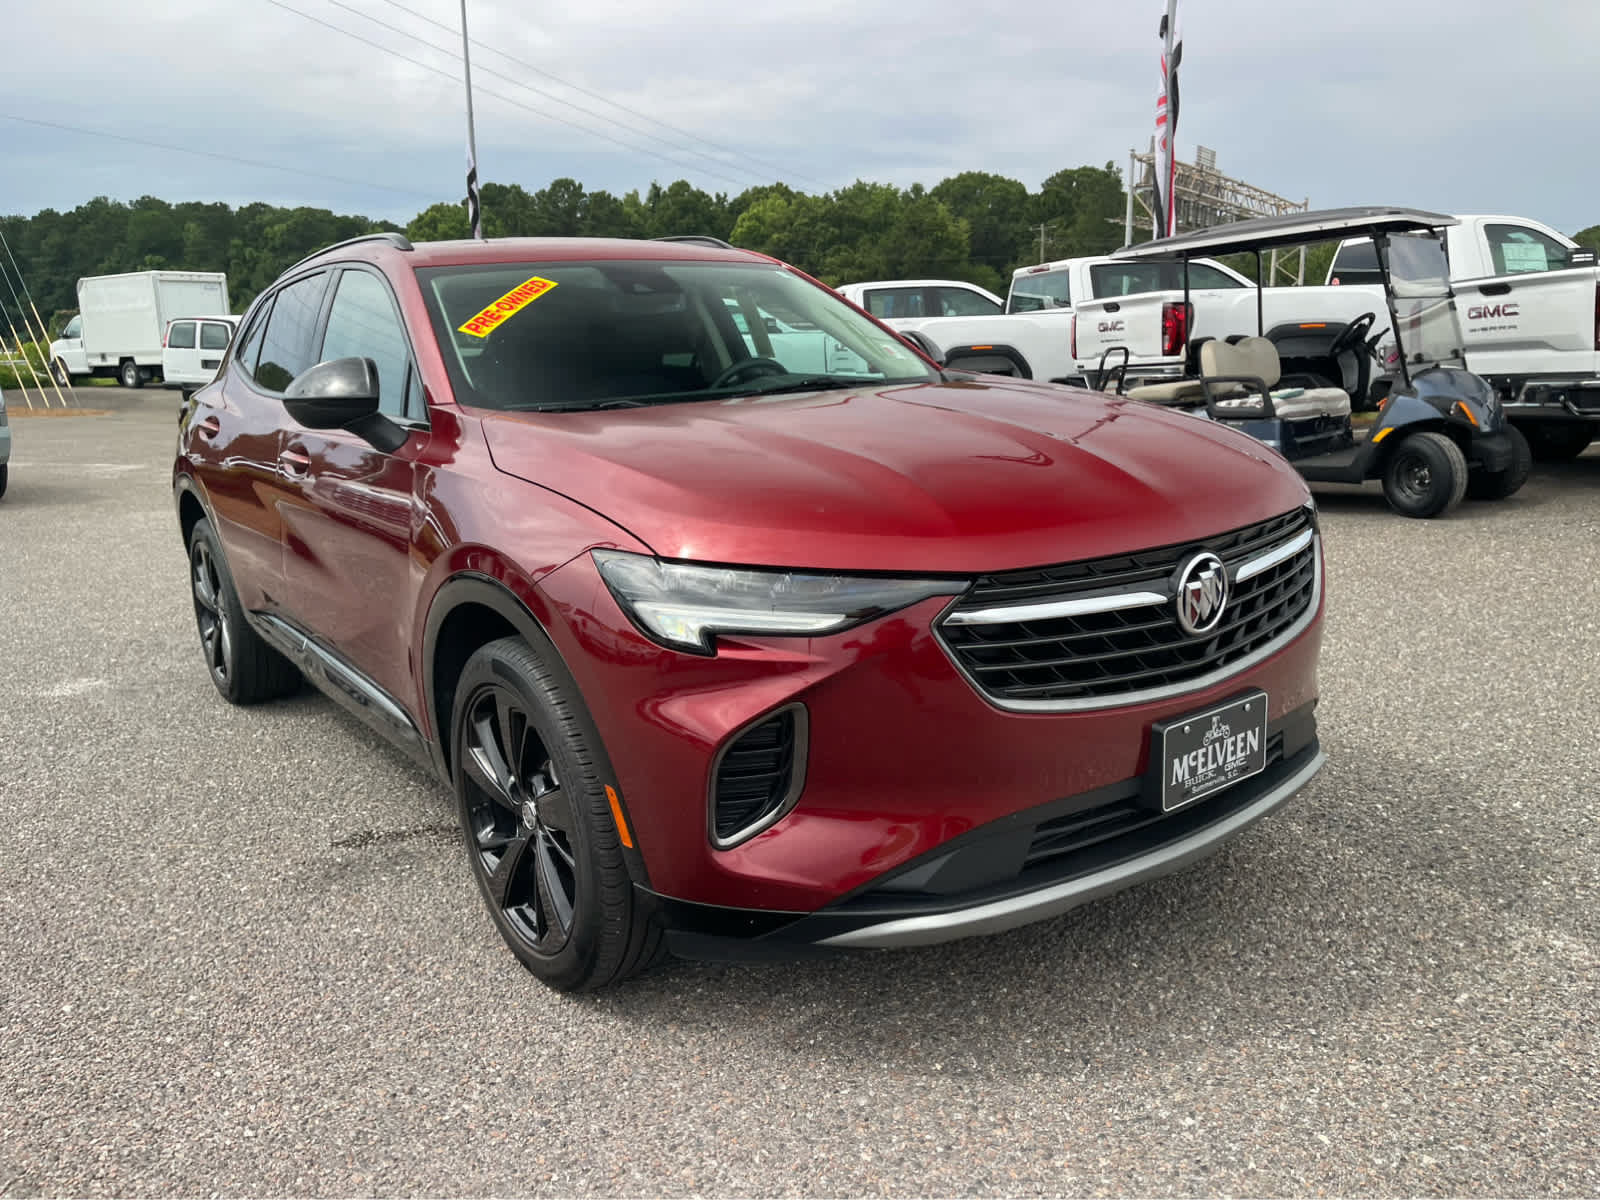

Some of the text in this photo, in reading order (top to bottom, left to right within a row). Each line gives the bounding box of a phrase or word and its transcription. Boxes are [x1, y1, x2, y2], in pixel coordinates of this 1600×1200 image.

[464, 280, 550, 335] PRE-OWNED
[1467, 303, 1520, 319] GMC
[1098, 320, 1125, 332] GMC
[1224, 758, 1247, 771] GMC
